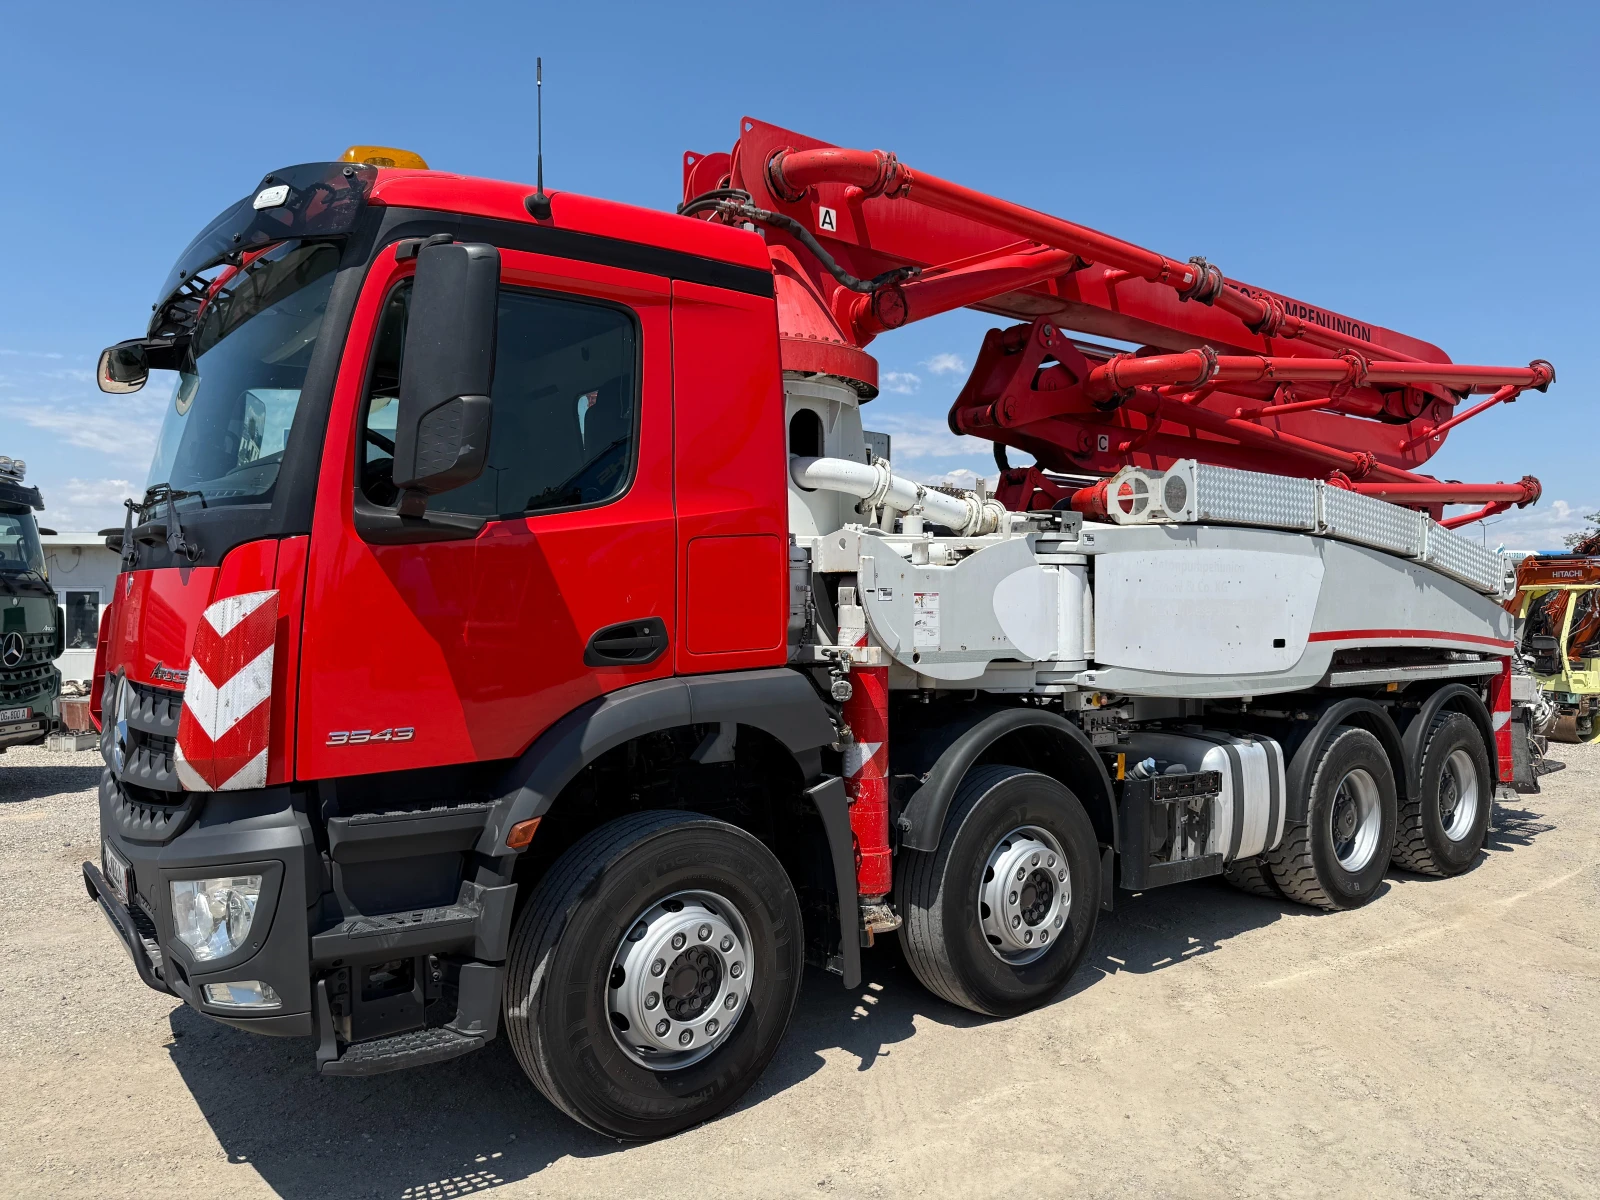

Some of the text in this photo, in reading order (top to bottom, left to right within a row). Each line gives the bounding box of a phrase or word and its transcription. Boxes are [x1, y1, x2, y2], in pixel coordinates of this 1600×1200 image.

[821, 209, 835, 230] A
[1098, 435, 1108, 451] C
[1552, 569, 1583, 578] HITACHI
[325, 727, 415, 745] 3543
